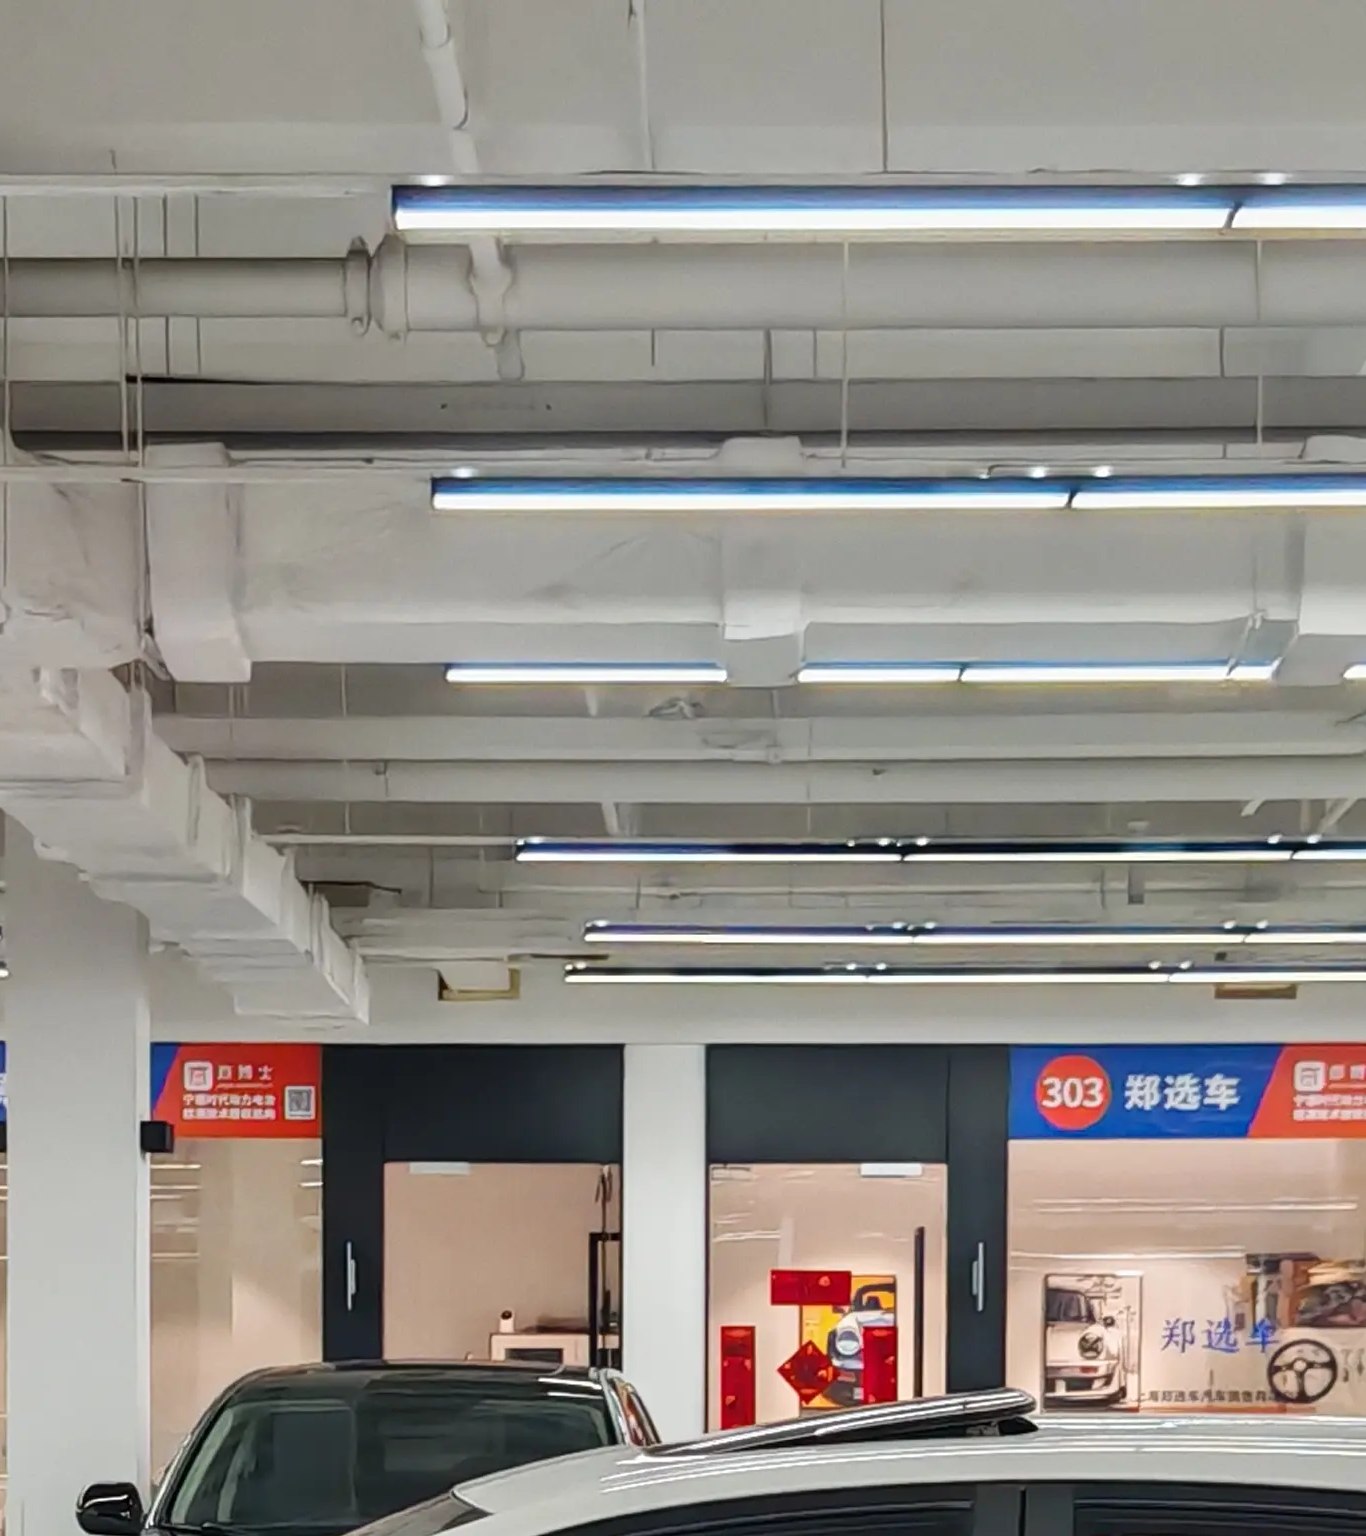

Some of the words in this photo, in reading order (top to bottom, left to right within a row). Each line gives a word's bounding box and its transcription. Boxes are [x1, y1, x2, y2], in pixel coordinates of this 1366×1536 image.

[1041, 1077, 1105, 1109] 303
[1123, 1073, 1241, 1110] 郑选车
[1161, 1316, 1280, 1354] 郑选车
